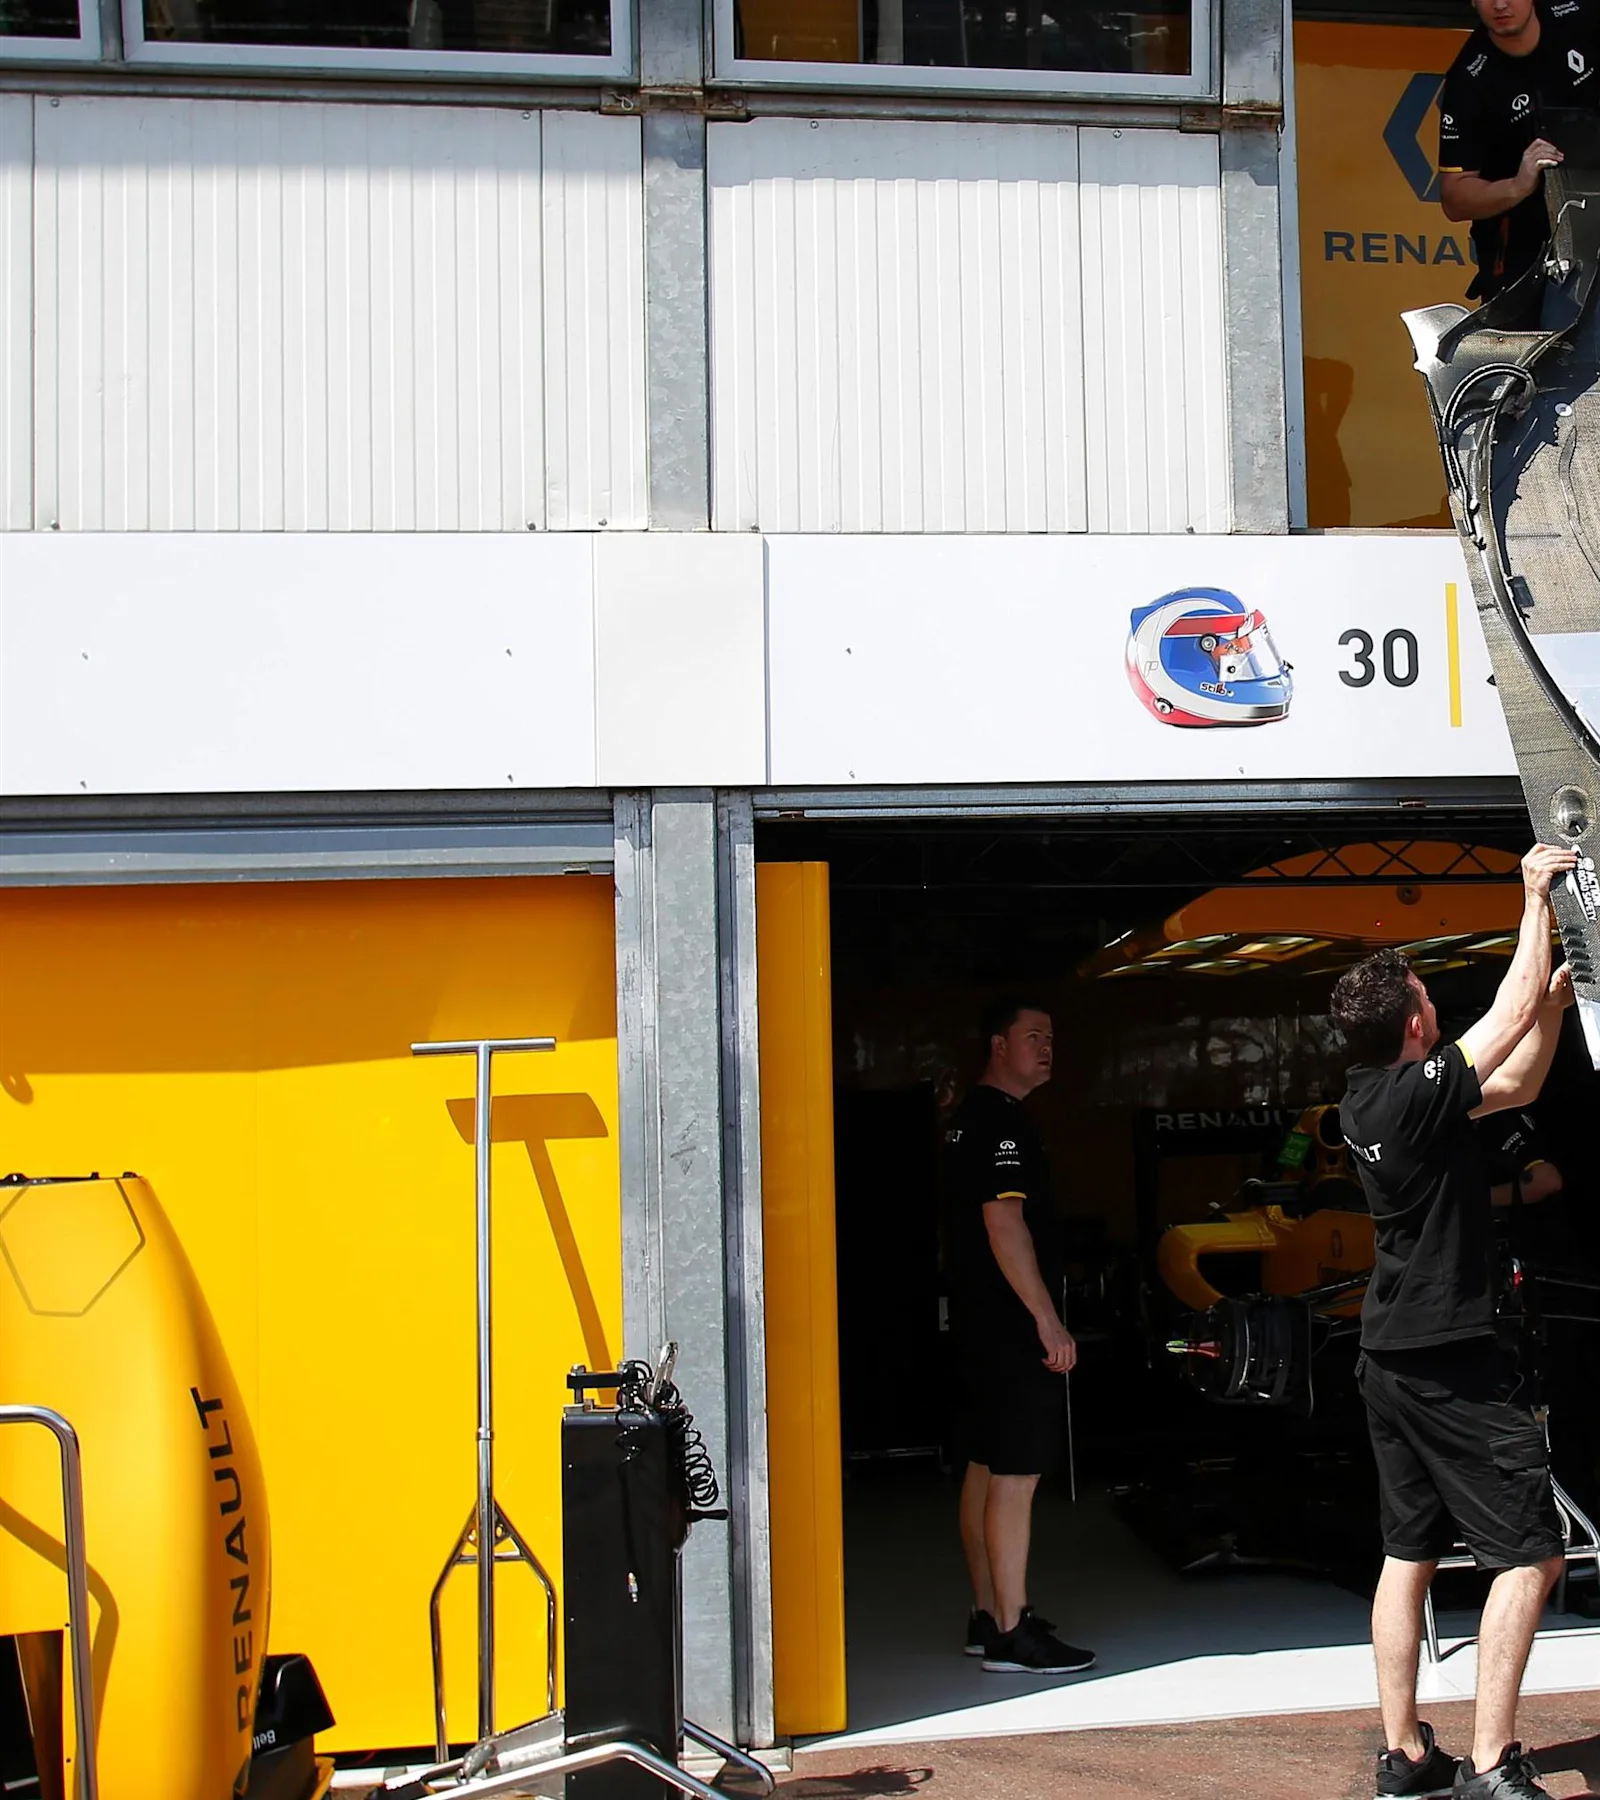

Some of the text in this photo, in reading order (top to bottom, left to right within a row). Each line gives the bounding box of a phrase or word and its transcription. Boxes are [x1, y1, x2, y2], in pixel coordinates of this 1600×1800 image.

[1337, 628, 1419, 688] 30
[1581, 891, 1598, 921] SAFETY
[190, 1386, 253, 1733] RENAULT
